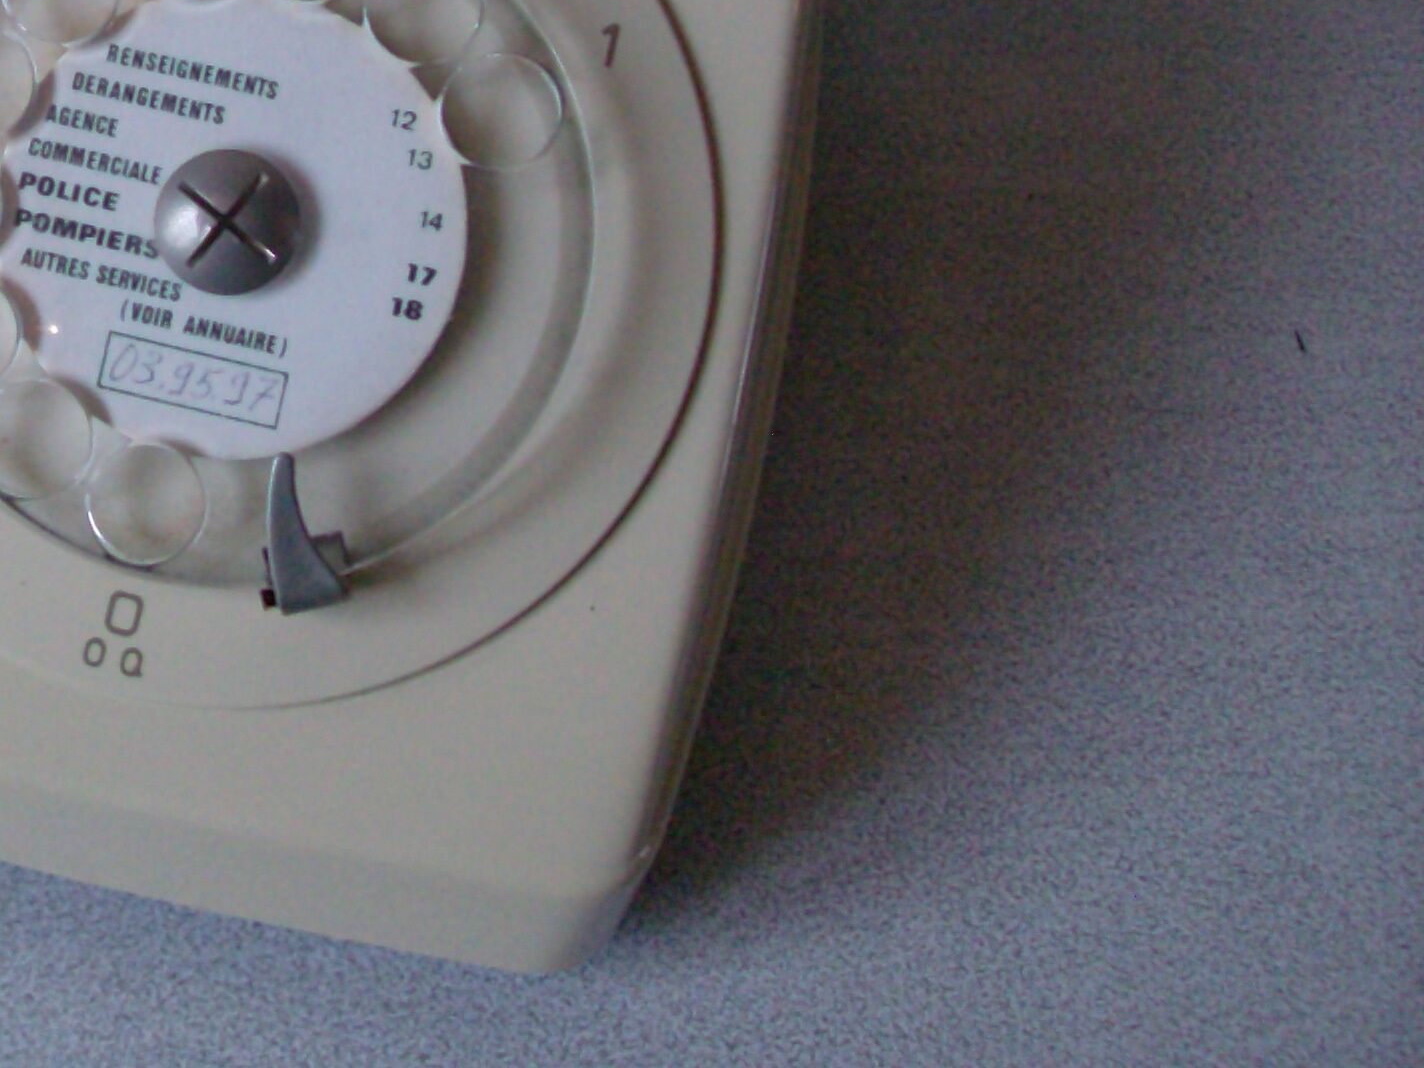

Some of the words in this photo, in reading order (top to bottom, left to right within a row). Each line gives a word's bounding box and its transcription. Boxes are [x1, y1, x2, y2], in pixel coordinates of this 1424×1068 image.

[601, 23, 621, 68] 1
[106, 43, 280, 100] RENSEIGNEMENTS
[72, 71, 226, 125] DERANGEMENTS
[391, 108, 418, 131] 12
[44, 104, 119, 138] AGENCE
[27, 137, 163, 185] COMMERCIALE
[408, 148, 433, 170] 13
[18, 171, 121, 212] POLICE
[13, 207, 159, 259] POMPIERS
[420, 211, 443, 232] 14
[21, 247, 91, 280] AUTRES
[95, 264, 183, 302] SERVICES
[407, 262, 437, 286] 17
[120, 299, 174, 330] (VOIR
[182, 315, 288, 359] ANNUAIRE)
[391, 297, 423, 321] 18
[105, 590, 144, 637] 0
